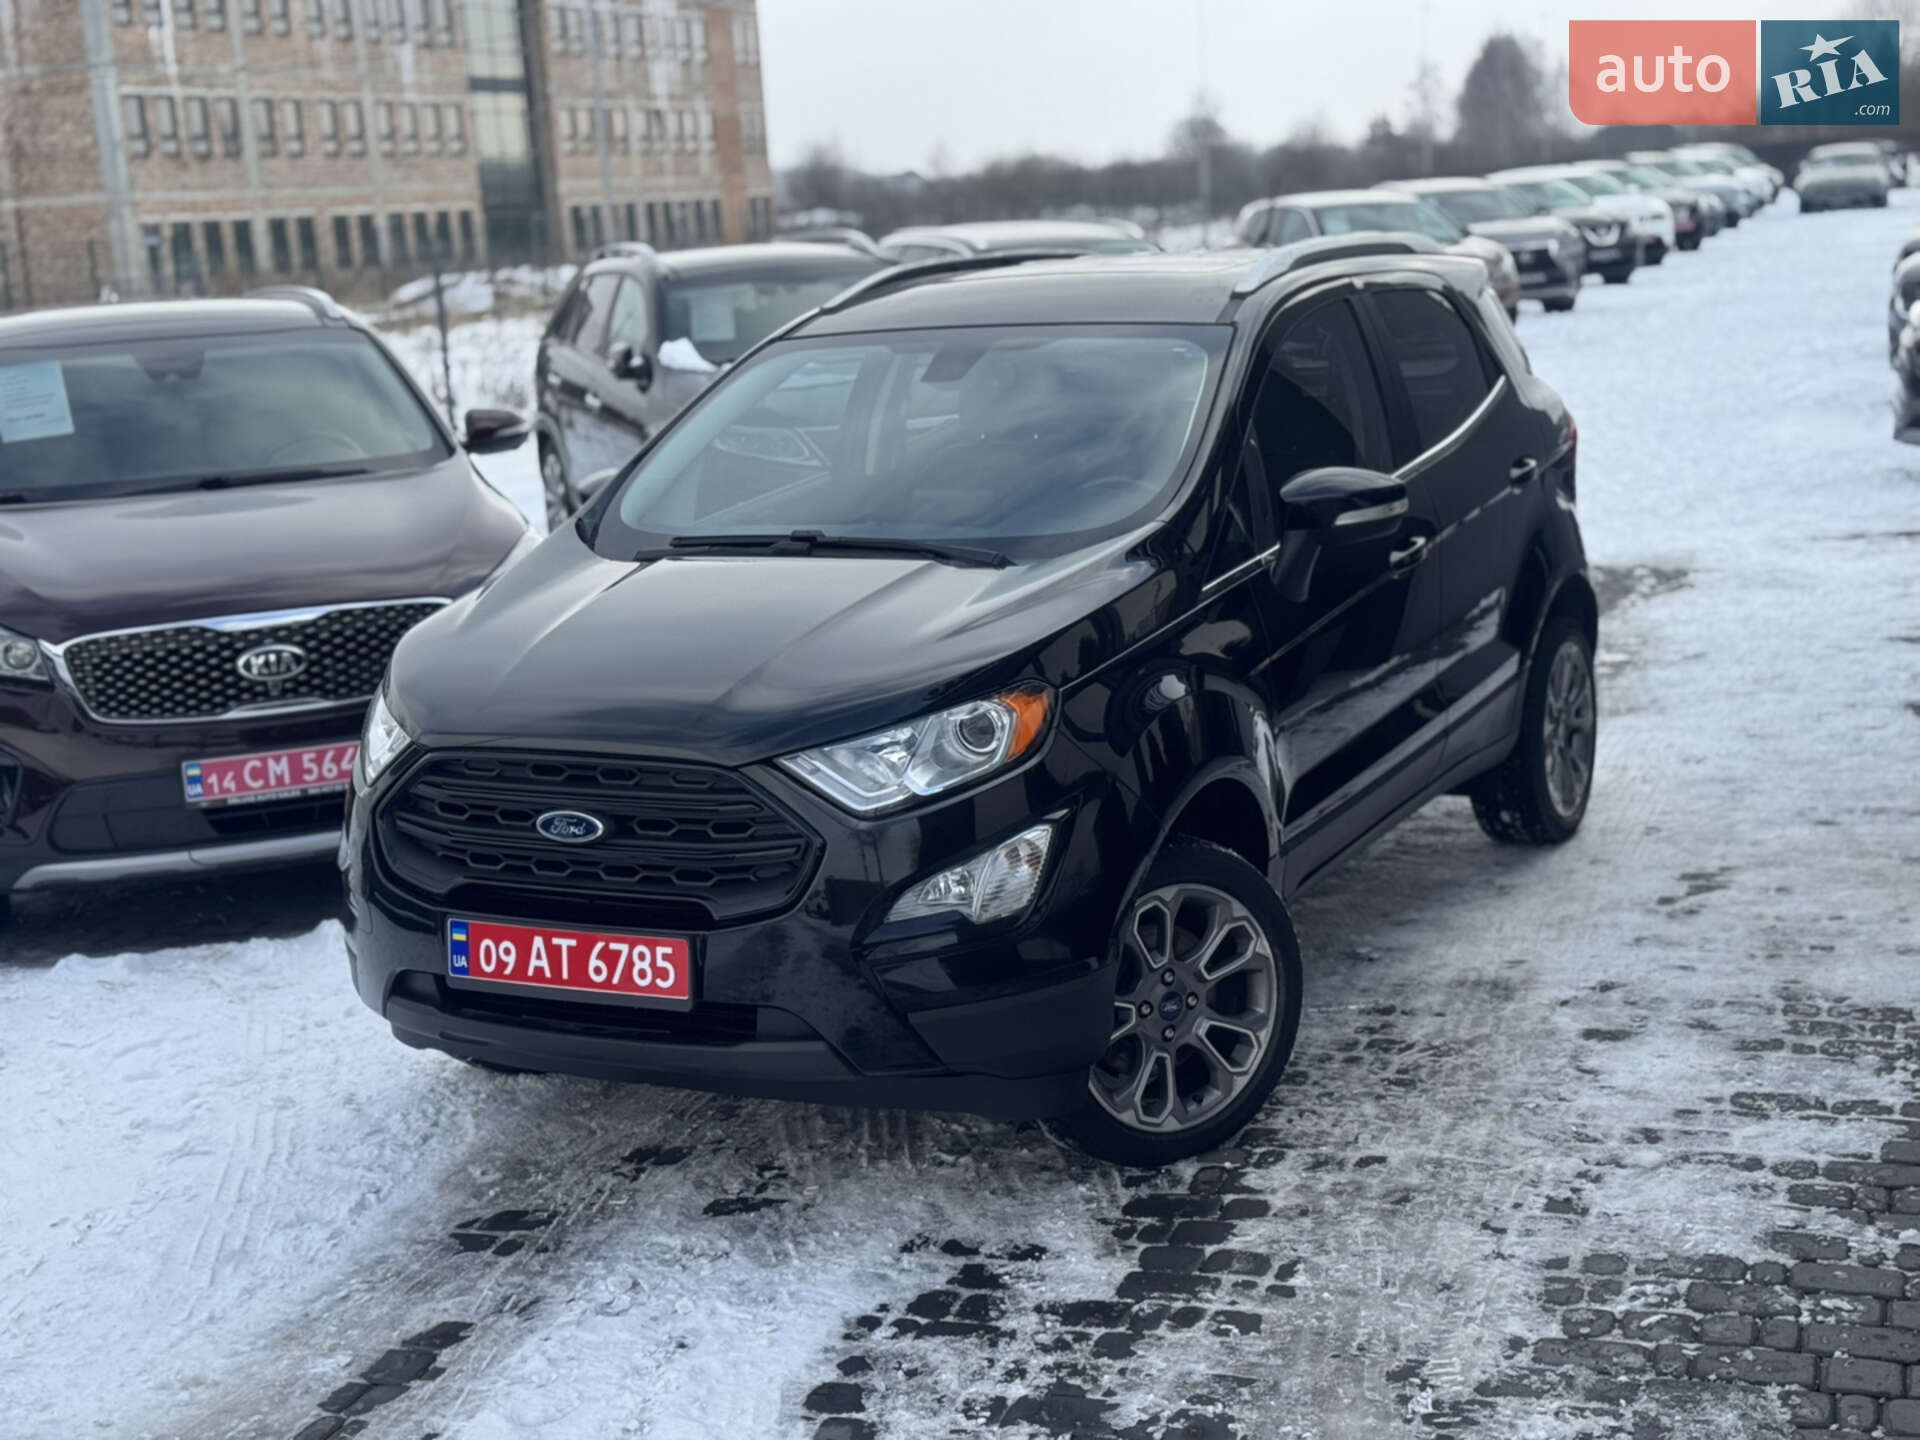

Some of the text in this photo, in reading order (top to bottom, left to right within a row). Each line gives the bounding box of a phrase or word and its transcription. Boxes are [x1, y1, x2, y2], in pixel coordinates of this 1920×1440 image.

[249, 651, 297, 675] KIA
[207, 771, 237, 794] 14
[243, 756, 291, 788] CM
[549, 816, 587, 836] Ford
[453, 955, 468, 968] UA
[479, 935, 676, 989] 09 AT 6785
